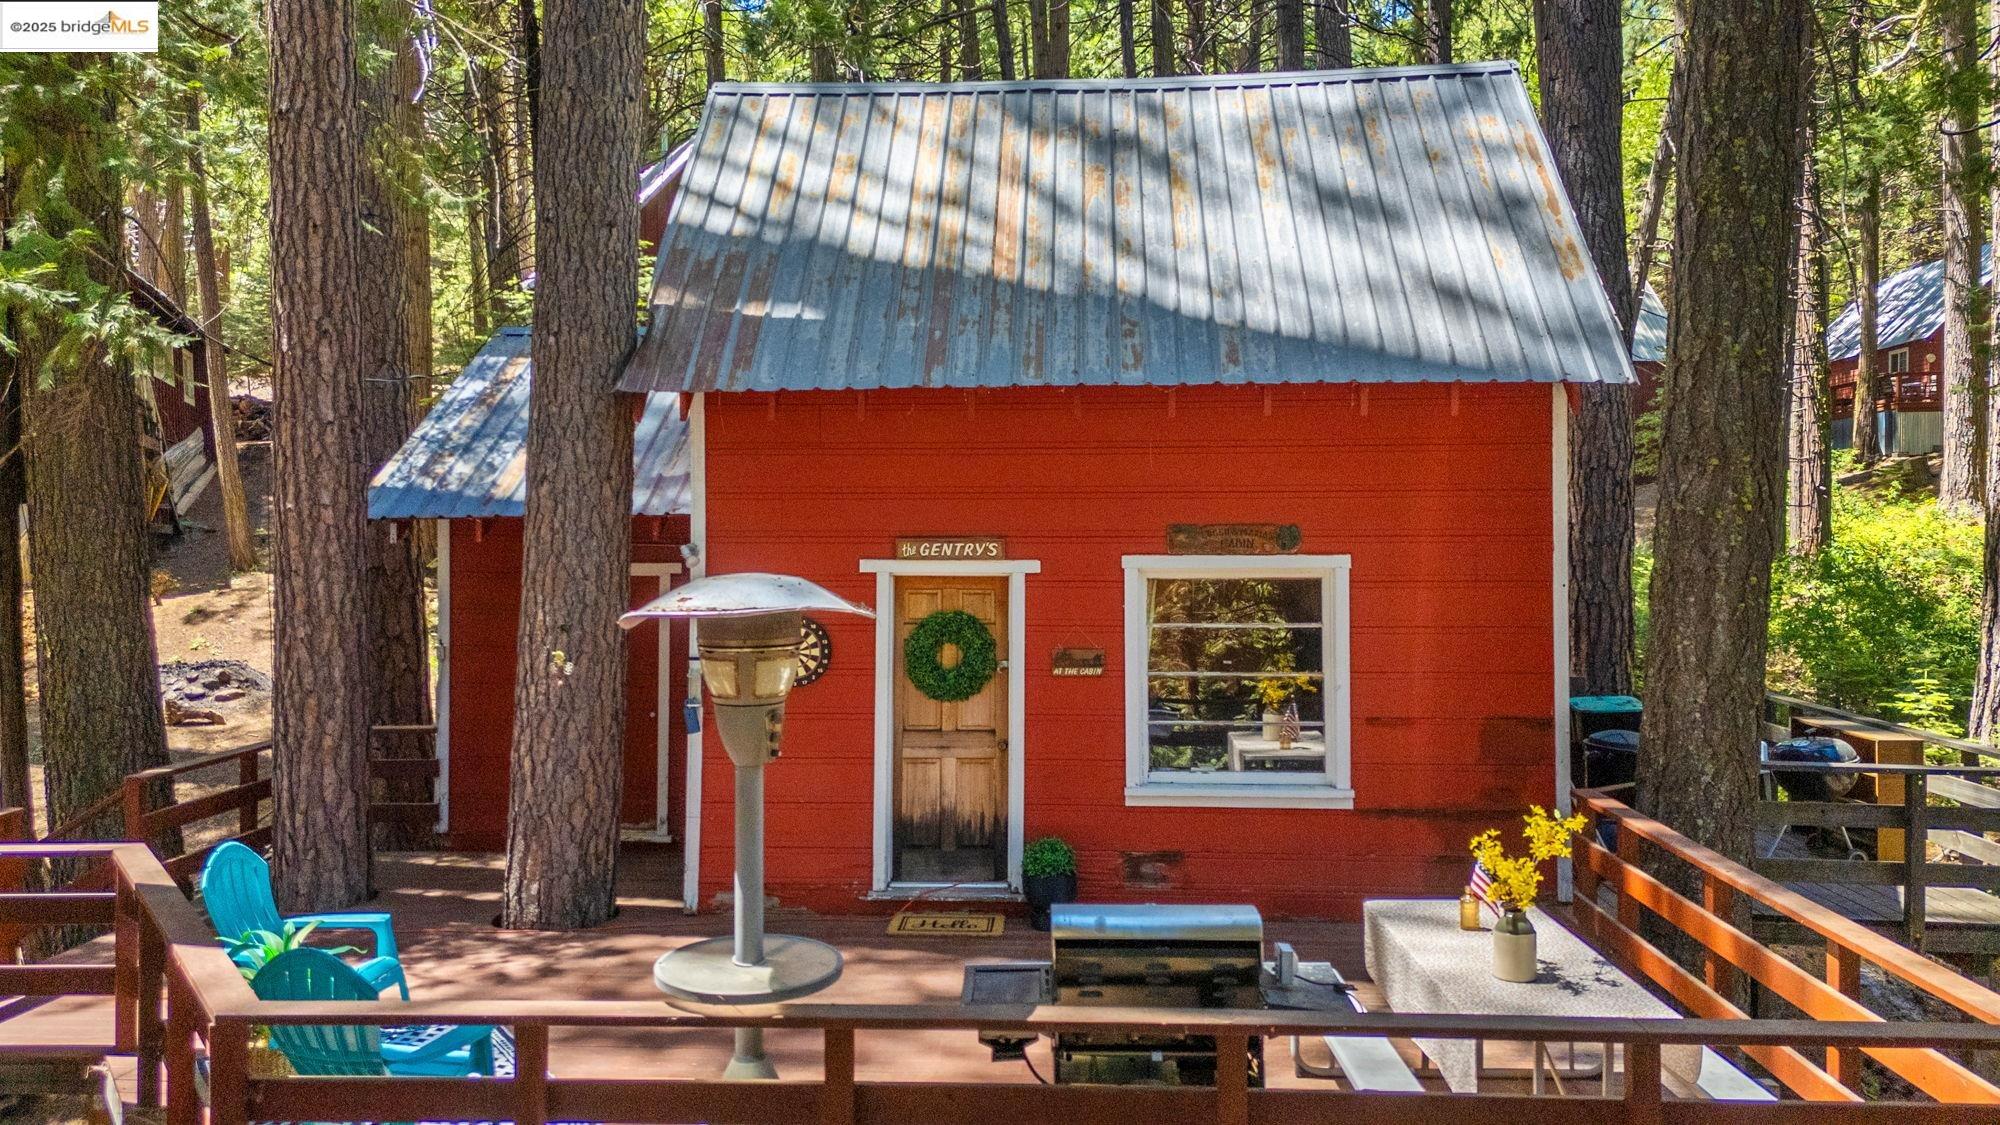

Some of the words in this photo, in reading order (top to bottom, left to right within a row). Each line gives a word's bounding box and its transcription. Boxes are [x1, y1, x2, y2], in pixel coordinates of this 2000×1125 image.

[902, 543, 916, 557] the
[919, 541, 999, 557] GENTRY'S
[1053, 667, 1063, 675] AT
[1064, 667, 1079, 675] THE
[1080, 667, 1103, 675] CABIN
[910, 919, 978, 929] Hello
